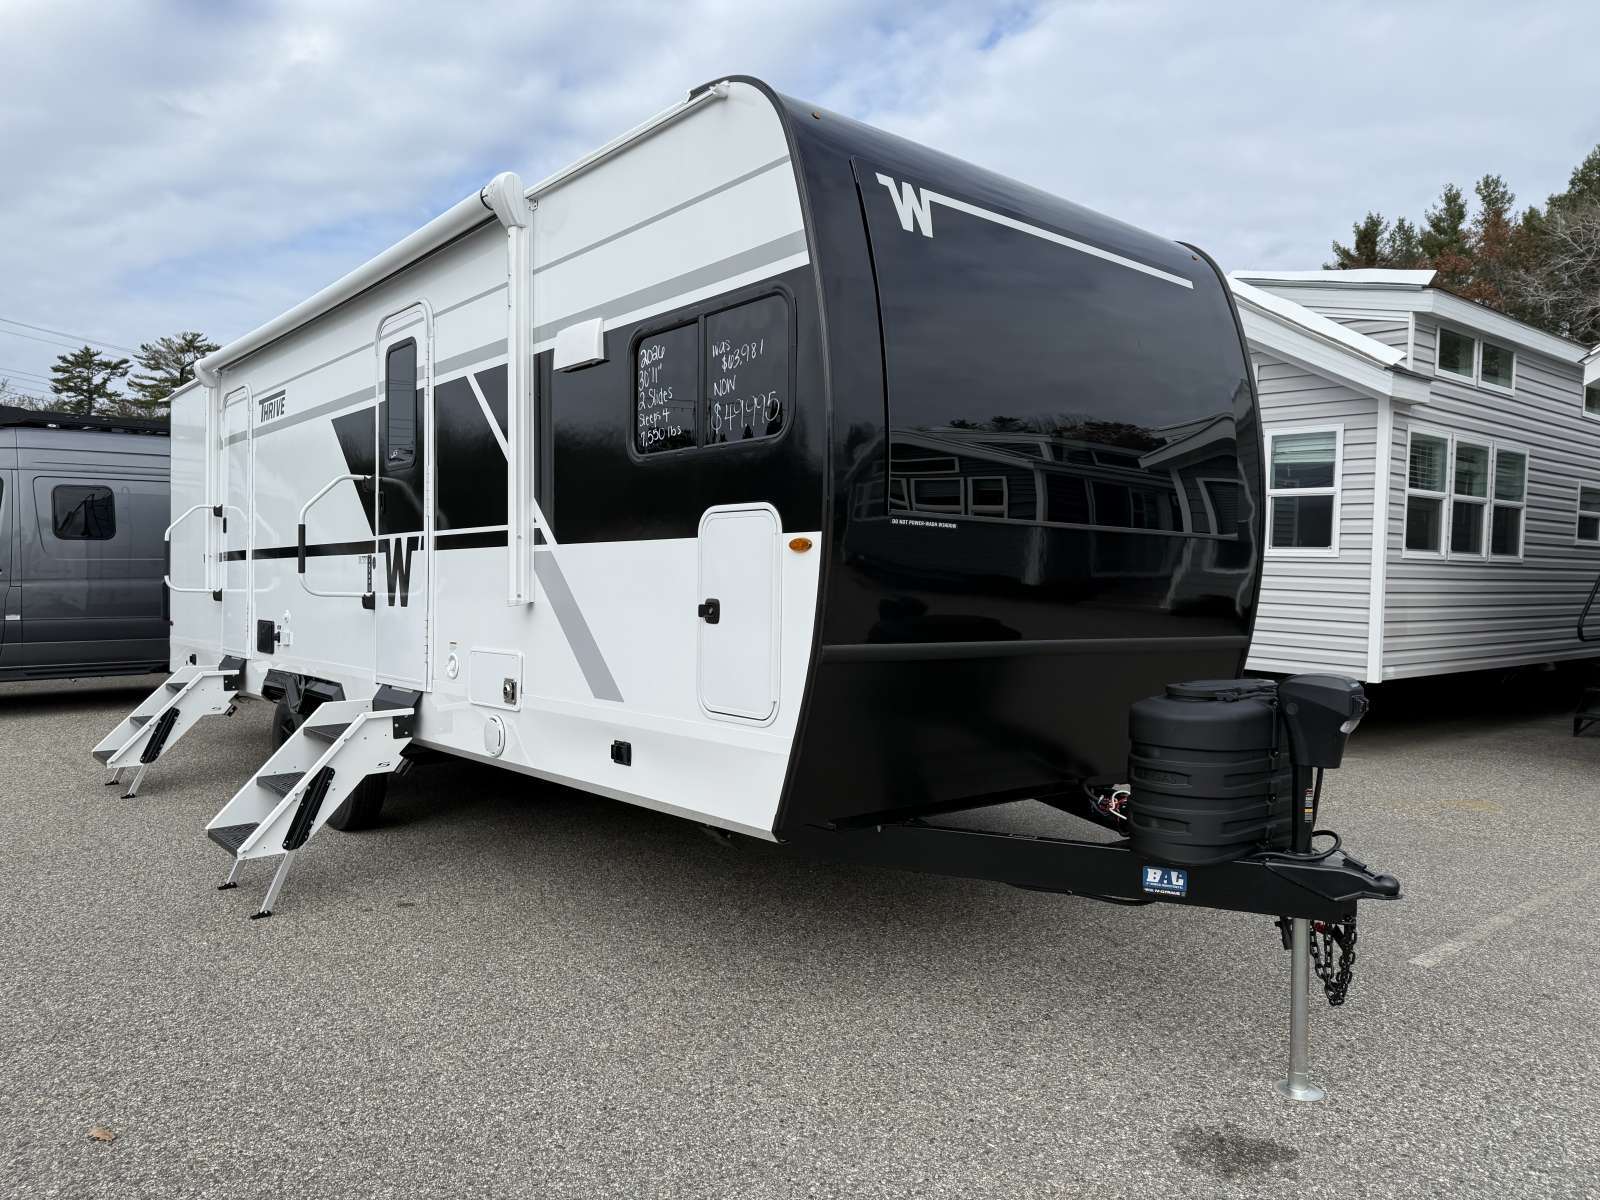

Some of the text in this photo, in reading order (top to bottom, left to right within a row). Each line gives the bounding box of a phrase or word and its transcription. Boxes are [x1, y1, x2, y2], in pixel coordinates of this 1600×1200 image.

[640, 345, 666, 368] 2026
[713, 374, 736, 397] NOW
[638, 391, 646, 411] 2
[662, 407, 671, 423] 4
